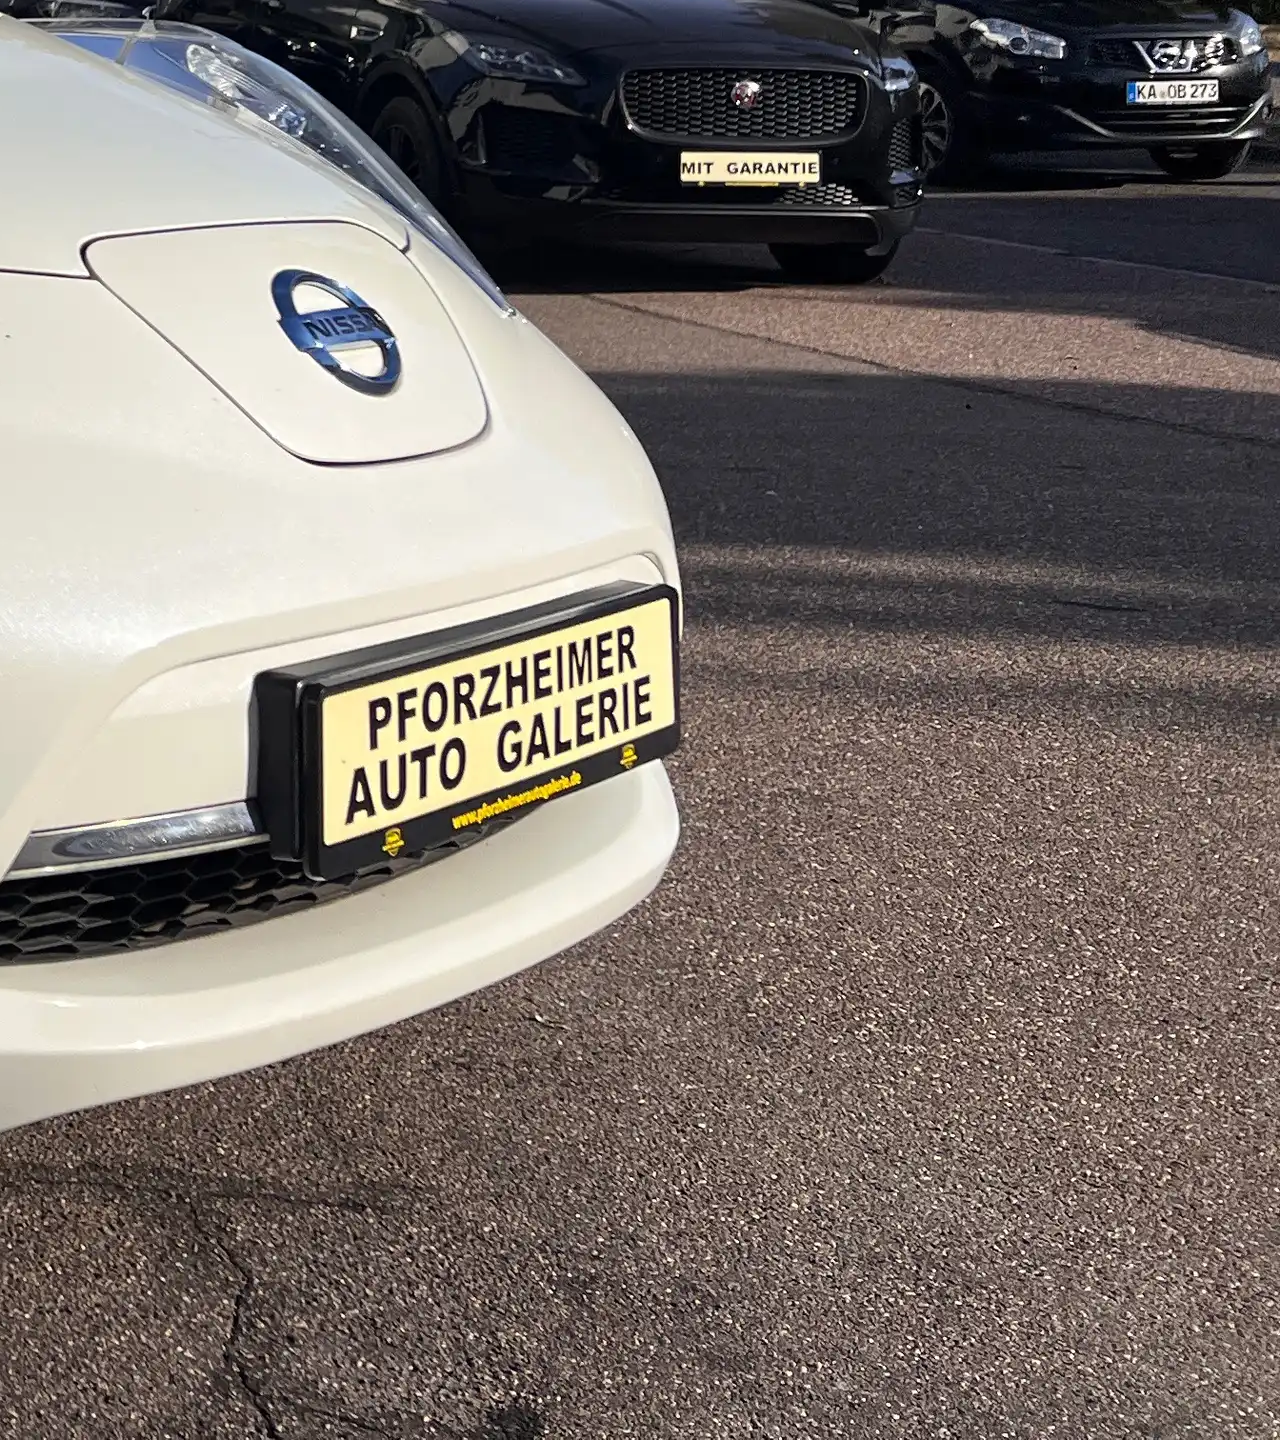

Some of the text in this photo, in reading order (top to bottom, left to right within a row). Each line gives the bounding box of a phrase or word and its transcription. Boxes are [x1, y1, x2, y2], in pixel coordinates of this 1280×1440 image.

[1137, 84, 1157, 99] KA
[1190, 83, 1217, 98] 273
[681, 161, 818, 175] MIT GARANTIE
[368, 624, 637, 751] PFORZHEIMER
[344, 675, 653, 825] AUTO GALERIE
